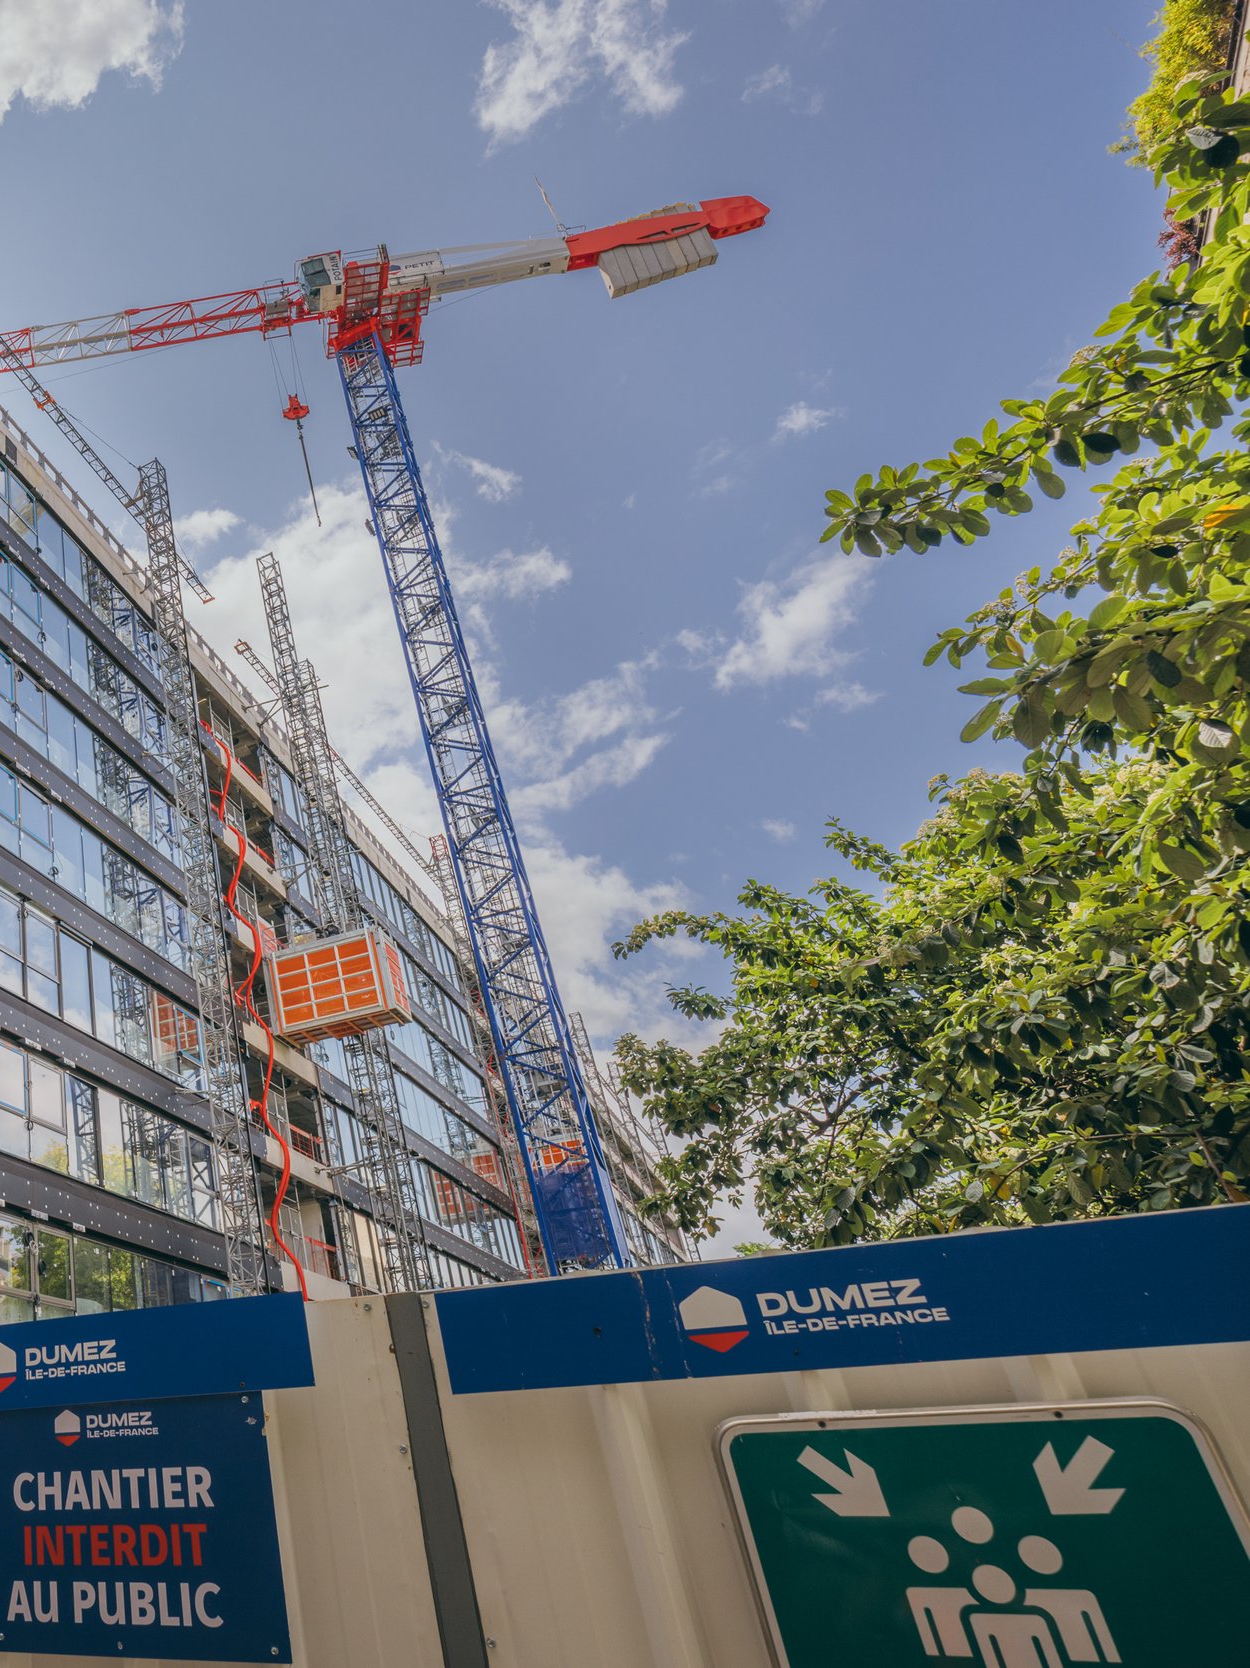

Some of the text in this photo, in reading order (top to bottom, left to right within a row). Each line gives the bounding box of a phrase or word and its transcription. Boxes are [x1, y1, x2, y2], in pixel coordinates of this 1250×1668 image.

[404, 260, 435, 270] PETIT
[756, 1278, 928, 1317] DUMEZ
[763, 1307, 950, 1335] ÎLE-DE-FRANCE
[25, 1339, 117, 1367] DUMEZ
[25, 1361, 126, 1381] ÎLE-DE-FRANCE
[86, 1411, 152, 1428] DUMEZ
[86, 1425, 159, 1439] ÎLE-DE-FRANCE
[13, 1466, 215, 1512] CHANTIER
[23, 1523, 207, 1567] INTERDIT
[6, 1580, 224, 1628] AU PUBLIC
